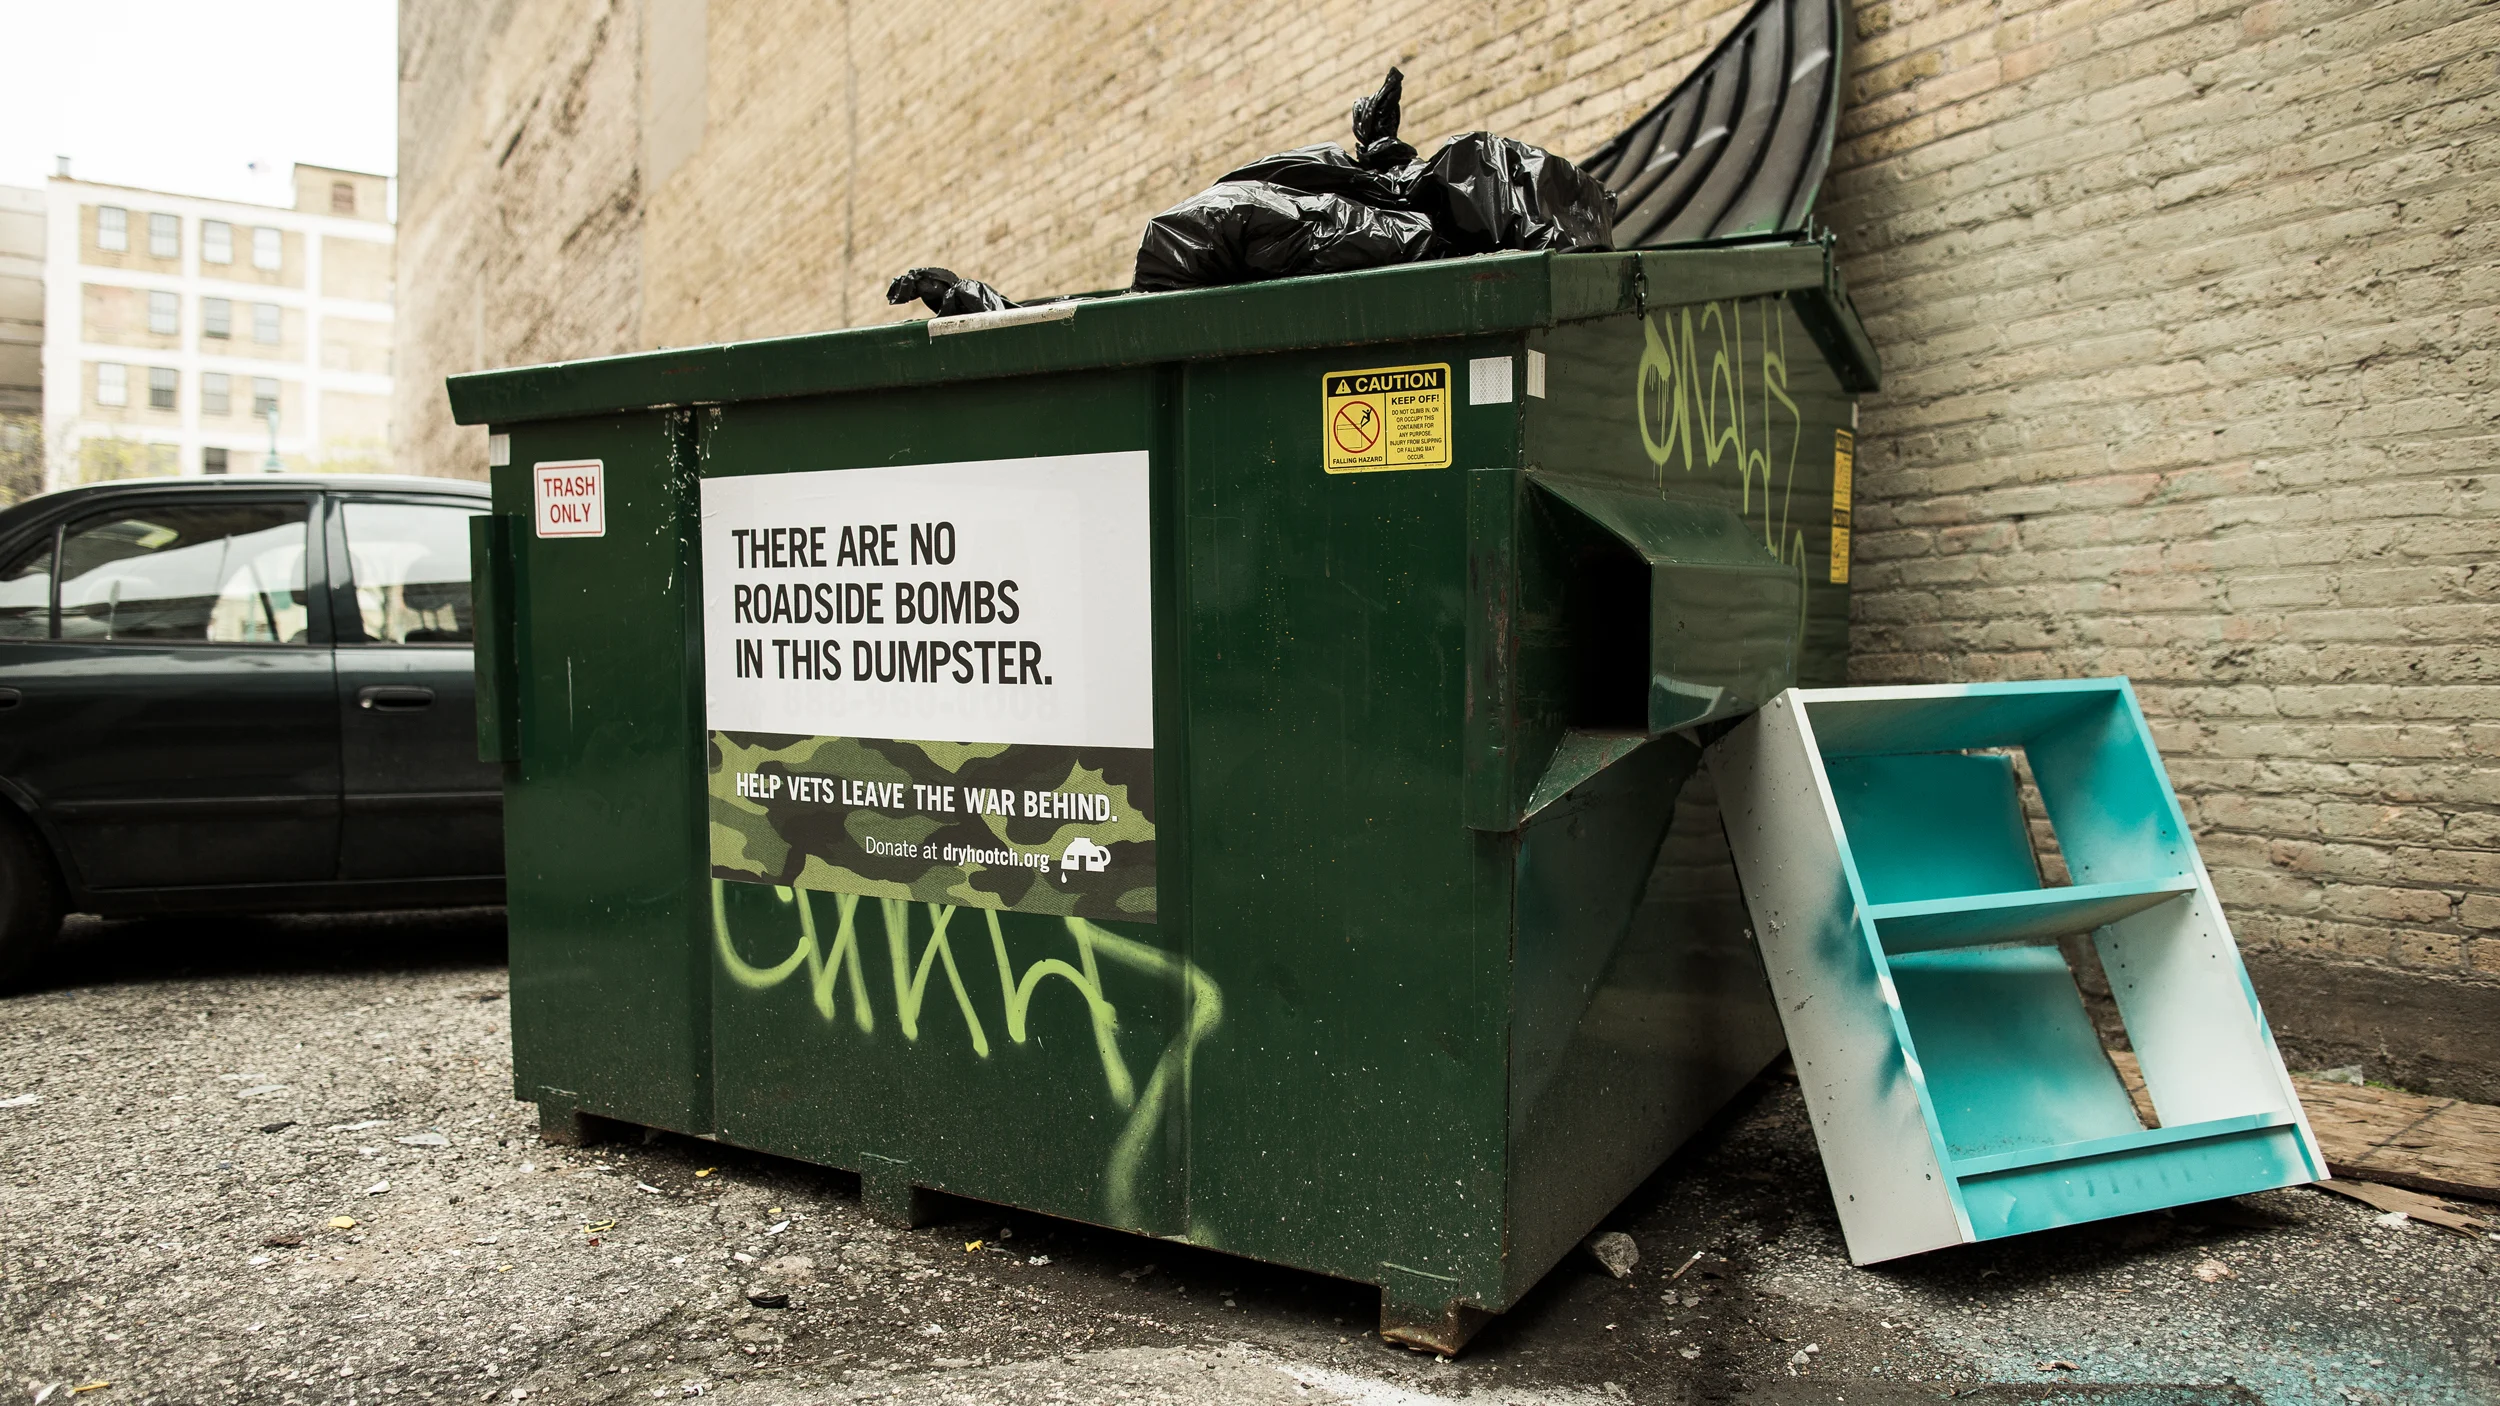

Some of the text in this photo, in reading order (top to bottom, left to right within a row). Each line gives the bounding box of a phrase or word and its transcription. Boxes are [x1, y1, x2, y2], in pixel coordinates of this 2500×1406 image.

[1356, 372, 1437, 393] CAUTION
[1391, 394, 1439, 405] KEEP OFF!
[543, 476, 595, 498] TRASH
[550, 503, 591, 523] ONLY
[732, 521, 955, 568] THERE ARE NO
[734, 579, 1019, 625] ROADSIDE BOMBS
[736, 638, 1052, 685] IN THIS DUMPSTER.
[736, 772, 1118, 822] HELP VETS LEAVE THE WAR BEHIND.
[865, 836, 1050, 872] Donate at dryhootch.org
